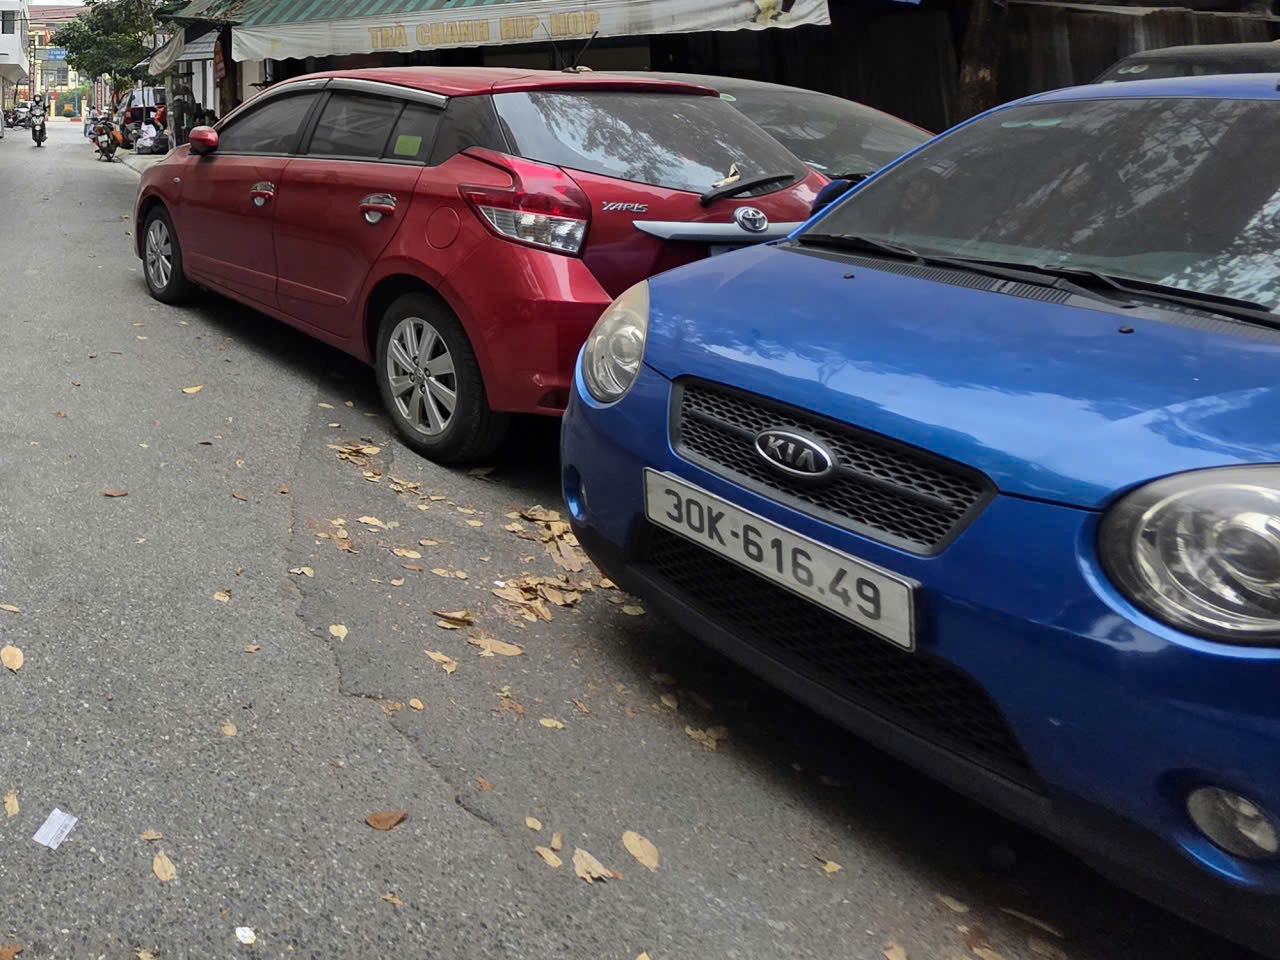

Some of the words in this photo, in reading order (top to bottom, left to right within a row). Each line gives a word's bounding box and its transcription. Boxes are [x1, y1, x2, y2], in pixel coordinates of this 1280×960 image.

[416, 19, 490, 46] CHANH
[499, 15, 540, 41] HIP
[549, 9, 600, 37] HOP
[601, 201, 649, 212] YARIS
[766, 433, 816, 473] KIA
[664, 488, 882, 621] 30K-616.49
